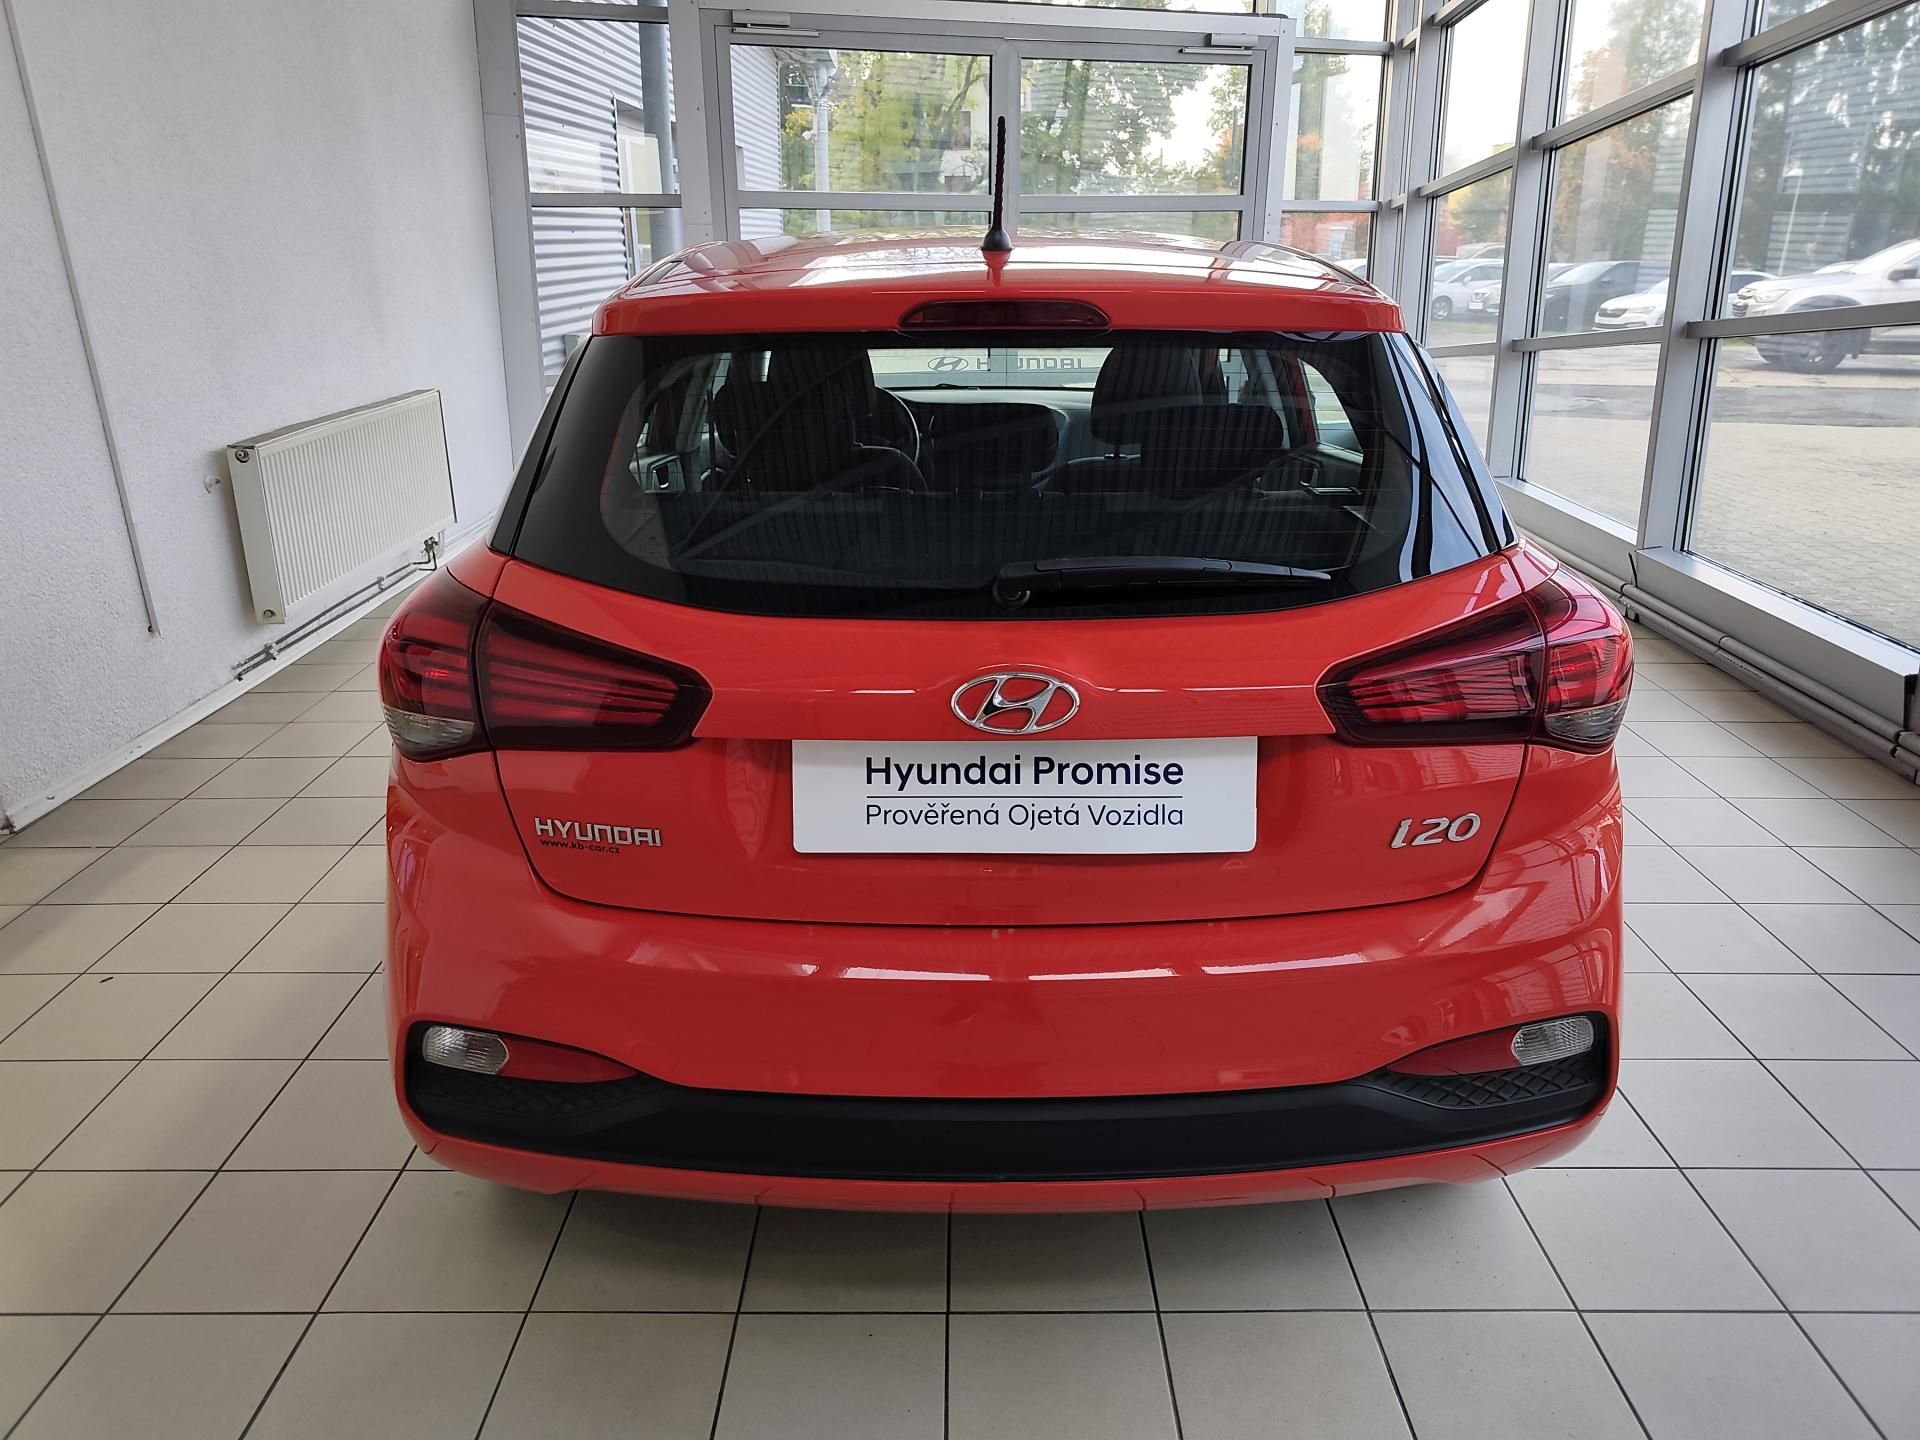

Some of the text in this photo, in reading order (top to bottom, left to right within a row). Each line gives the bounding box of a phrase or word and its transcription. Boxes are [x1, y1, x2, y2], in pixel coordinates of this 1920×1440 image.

[866, 755, 1184, 791] Hyundai Promise
[866, 801, 1184, 831] Prověřená Ojetá Vozidla
[534, 817, 662, 847] HYUNDAI
[540, 839, 620, 854] www.kb-car.cz
